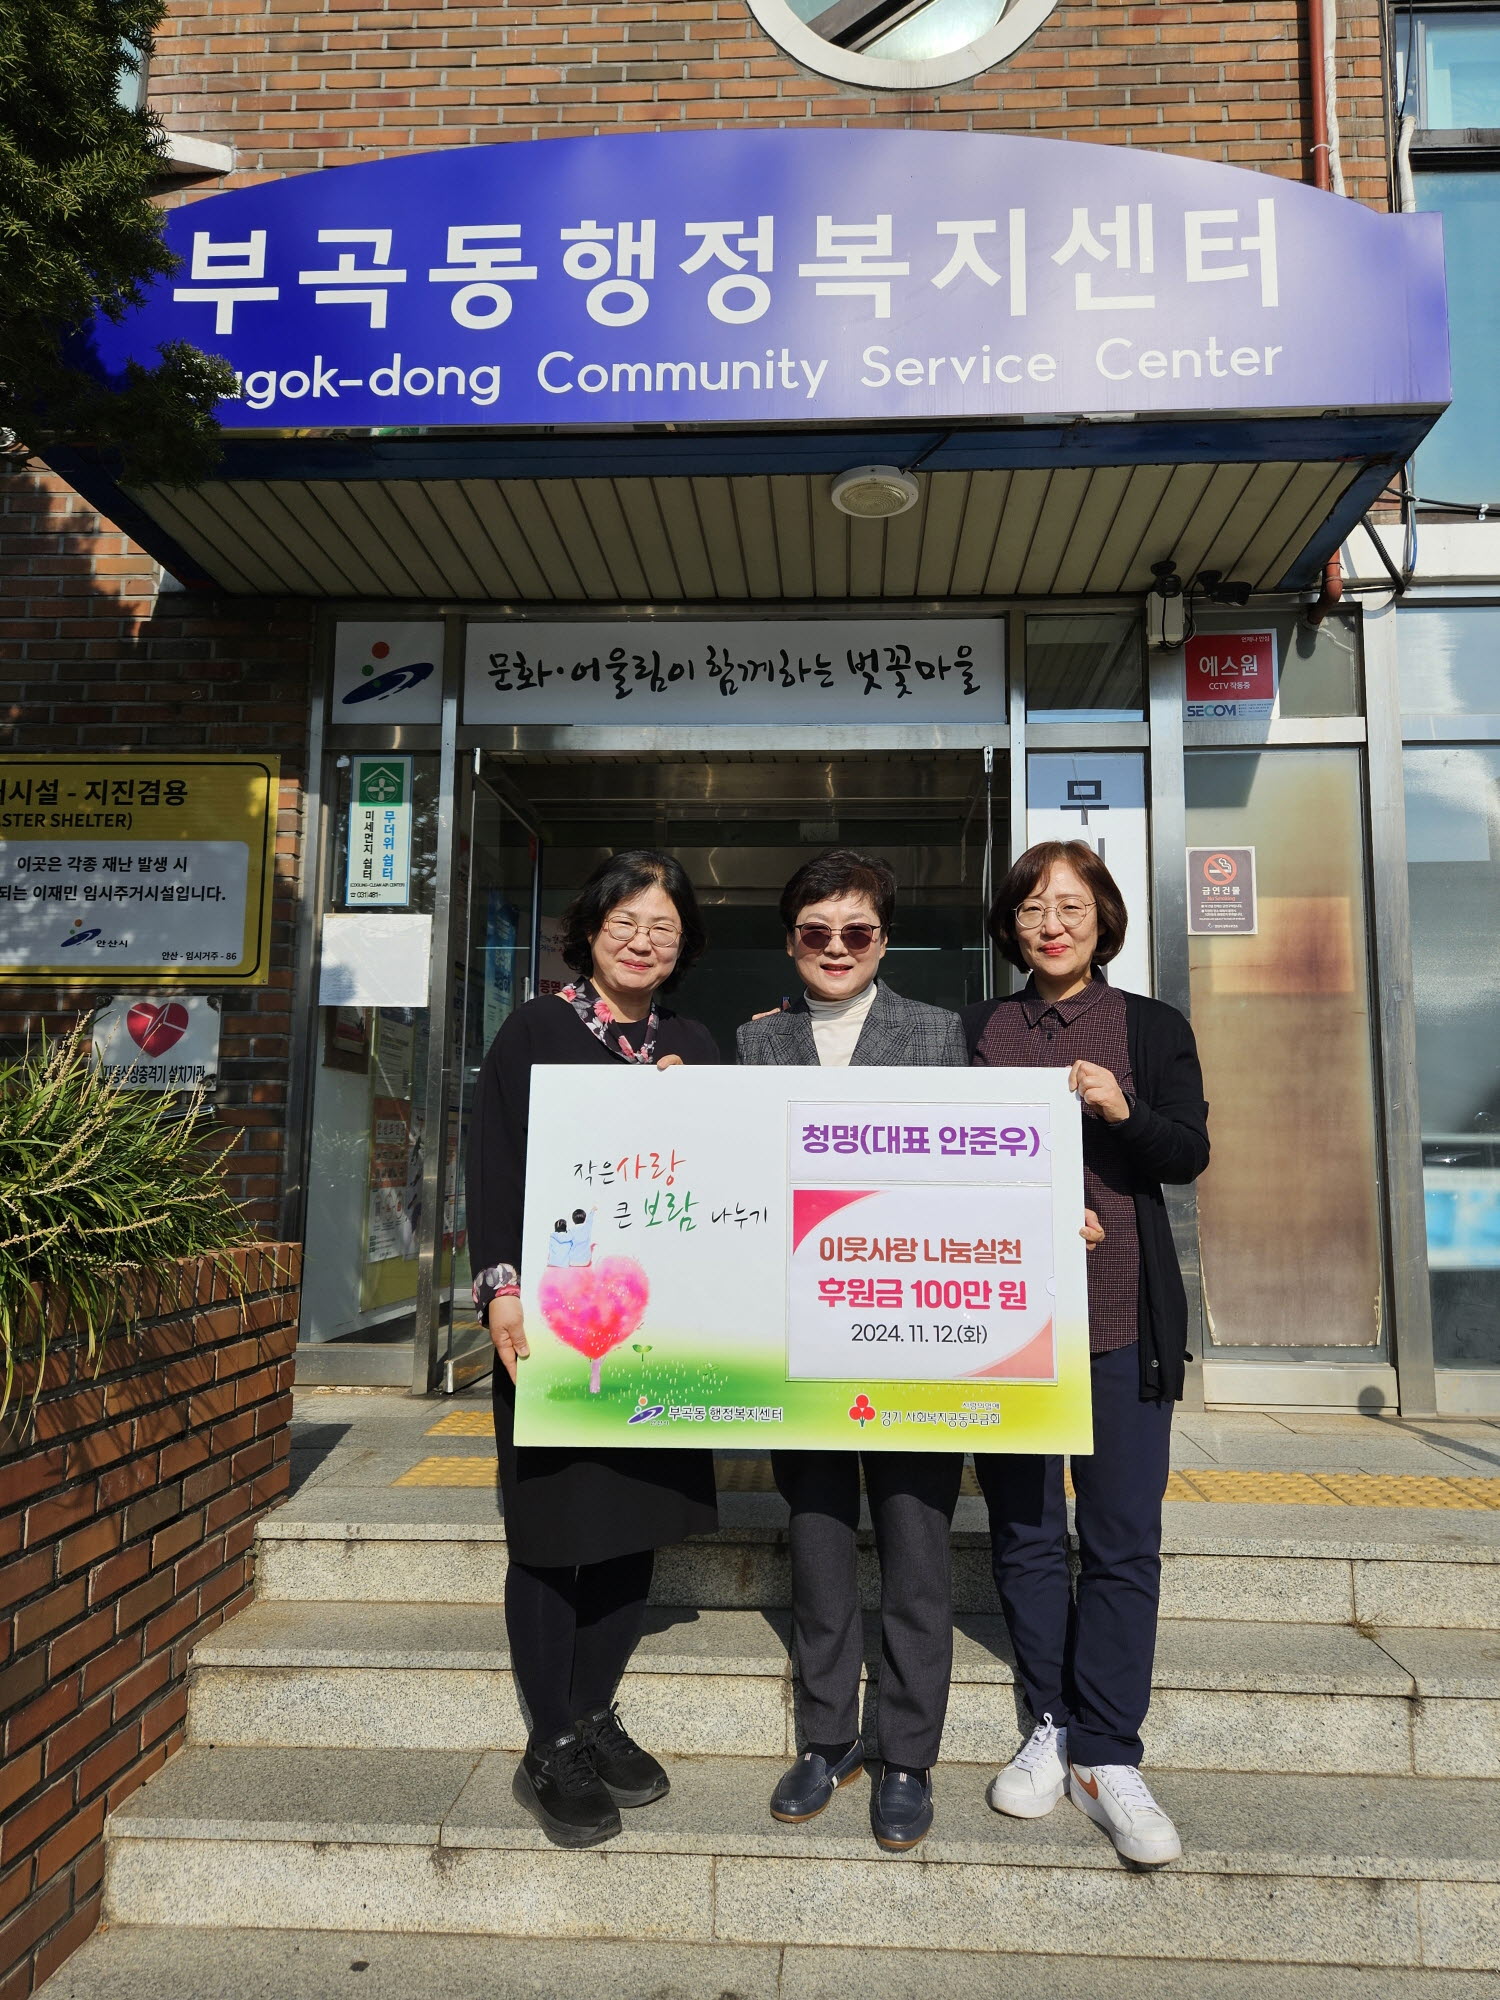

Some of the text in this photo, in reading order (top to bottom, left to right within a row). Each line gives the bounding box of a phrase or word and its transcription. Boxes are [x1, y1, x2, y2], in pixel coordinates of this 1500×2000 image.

[537, 349, 829, 399] Community
[860, 344, 1057, 388] Service
[1096, 336, 1283, 380] Center
[706, 644, 834, 697] 함께하는
[1200, 655, 1258, 676] 에스원
[1209, 681, 1251, 690] CCTV 작동중
[1187, 704, 1237, 717] SECOM
[84, 778, 188, 807] 지진겸용
[0, 812, 133, 831] STER SHELTER)
[362, 810, 375, 880] 미세먼지 쉼터
[382, 811, 396, 880] 무더위 쉼터
[17, 856, 188, 872] 이곳은 각종 재난 발생 시
[33, 885, 78, 900] 이재민
[83, 886, 226, 901] 임시주거시설입니다.
[96, 940, 128, 948] 안산시
[161, 952, 178, 961] 안산
[186, 952, 218, 961] 임시거주
[226, 952, 237, 961] 86
[802, 1124, 1040, 1157] 청명(대표 안준우)
[613, 1190, 768, 1232] 큰 보람 나누기
[819, 1236, 1022, 1265] 이웃사랑 나눔실천
[817, 1277, 904, 1309] 후원금
[669, 1406, 783, 1422] 부곡동 행정복지센터
[881, 1411, 1001, 1428] 경기 사회복지공동모금회
